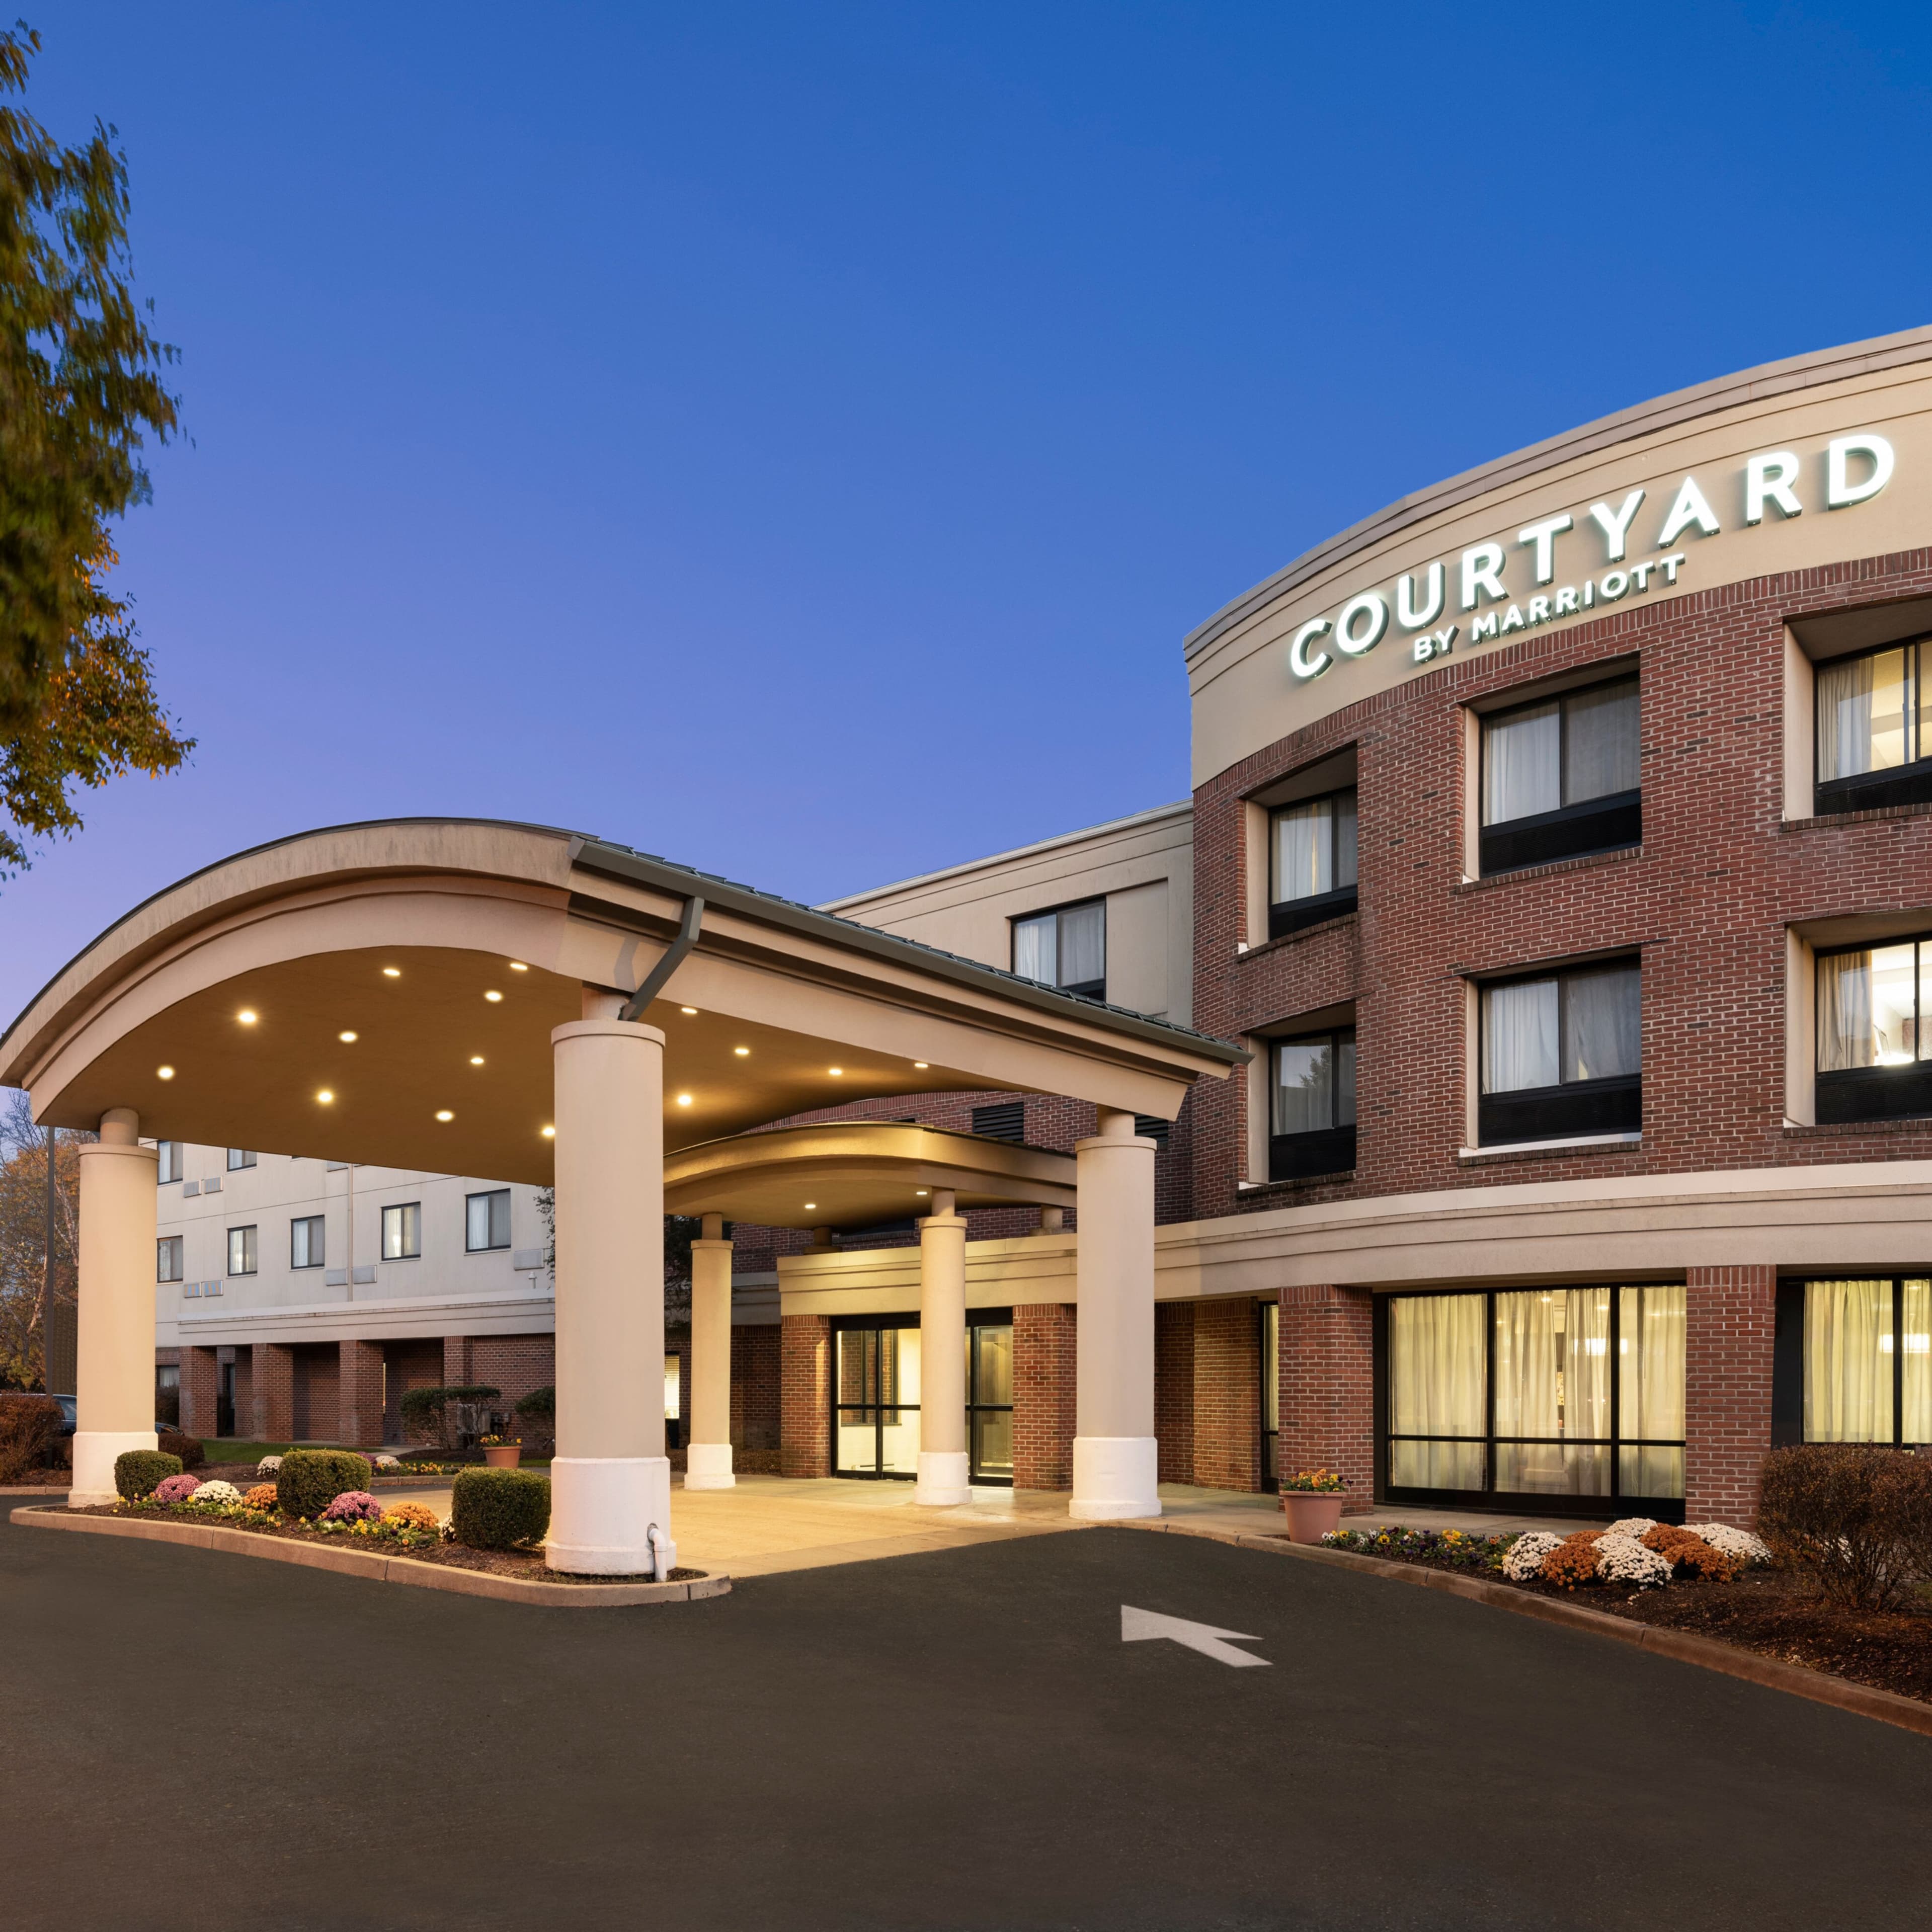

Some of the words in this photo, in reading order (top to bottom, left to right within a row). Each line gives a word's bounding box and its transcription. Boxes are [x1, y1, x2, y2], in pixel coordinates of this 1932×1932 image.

[1290, 434, 1895, 678] COURTYARD
[1414, 625, 1460, 662] BY
[1472, 553, 1685, 643] MARRIOTT
